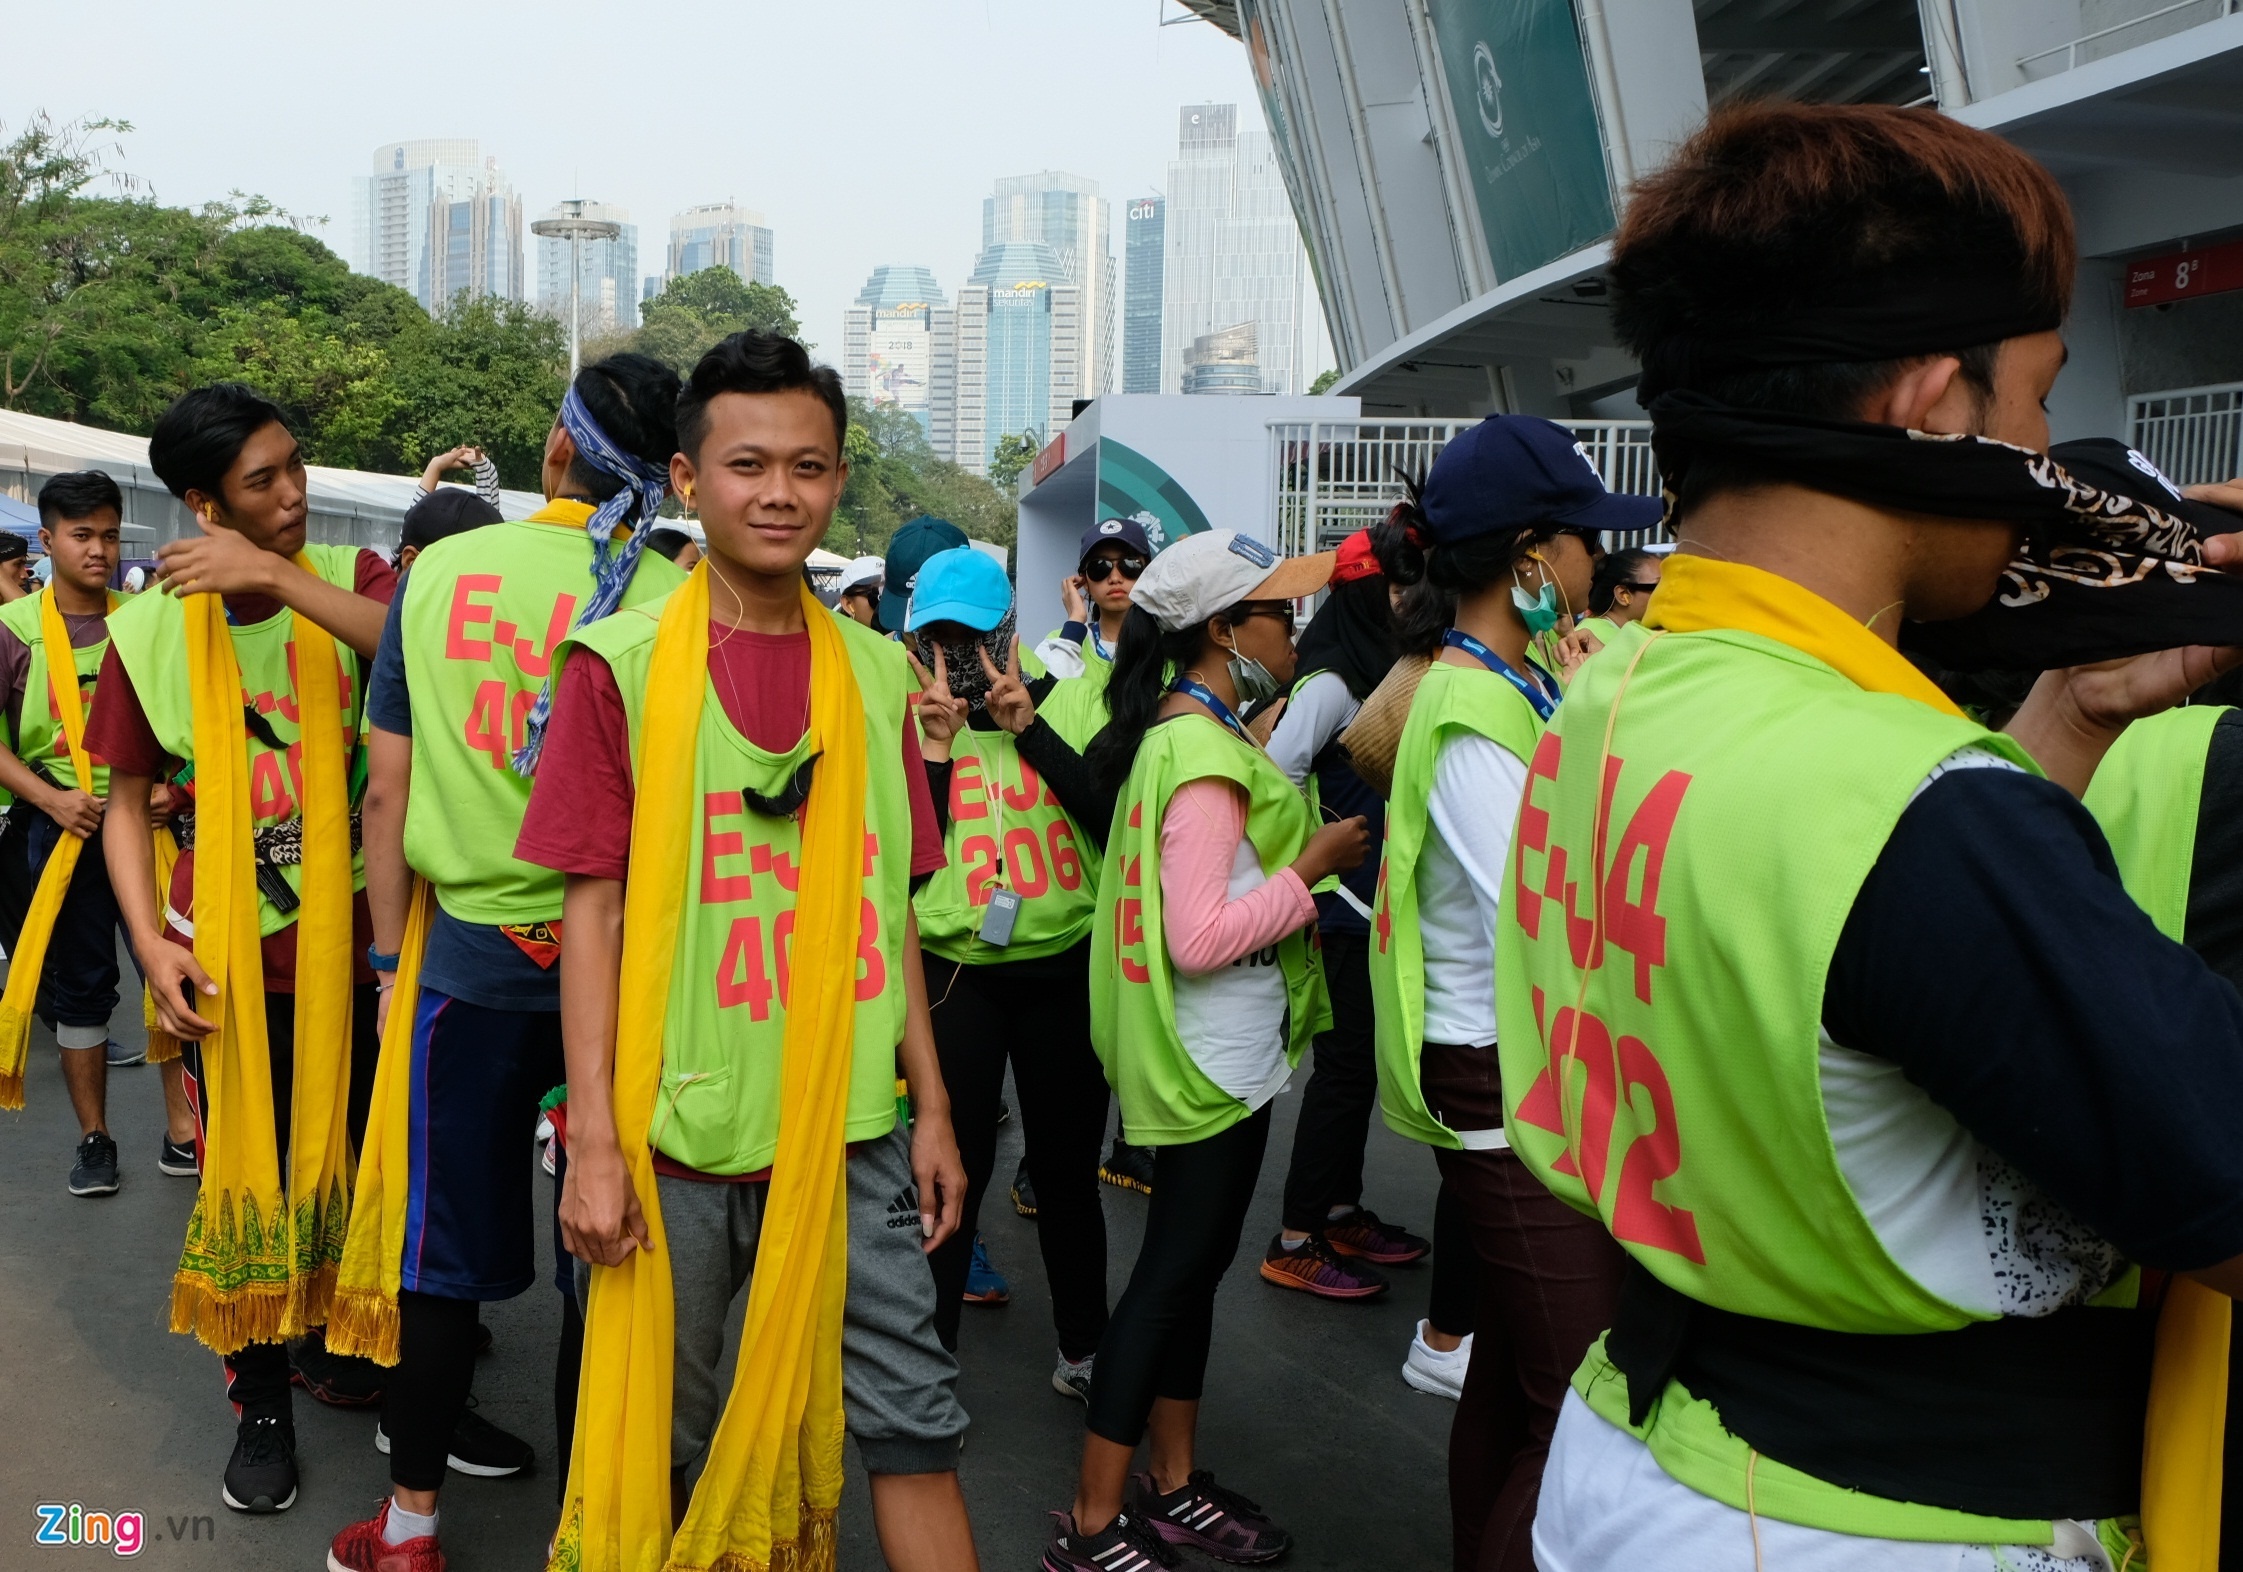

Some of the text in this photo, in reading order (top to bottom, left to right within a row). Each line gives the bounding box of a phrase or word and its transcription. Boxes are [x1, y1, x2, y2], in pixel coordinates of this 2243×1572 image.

[1129, 203, 1154, 220] citi
[2132, 271, 2155, 283] Zona
[994, 287, 1035, 298] mandiri
[876, 308, 917, 318] mandiri
[445, 574, 577, 678] E-J
[961, 819, 1082, 907] 206
